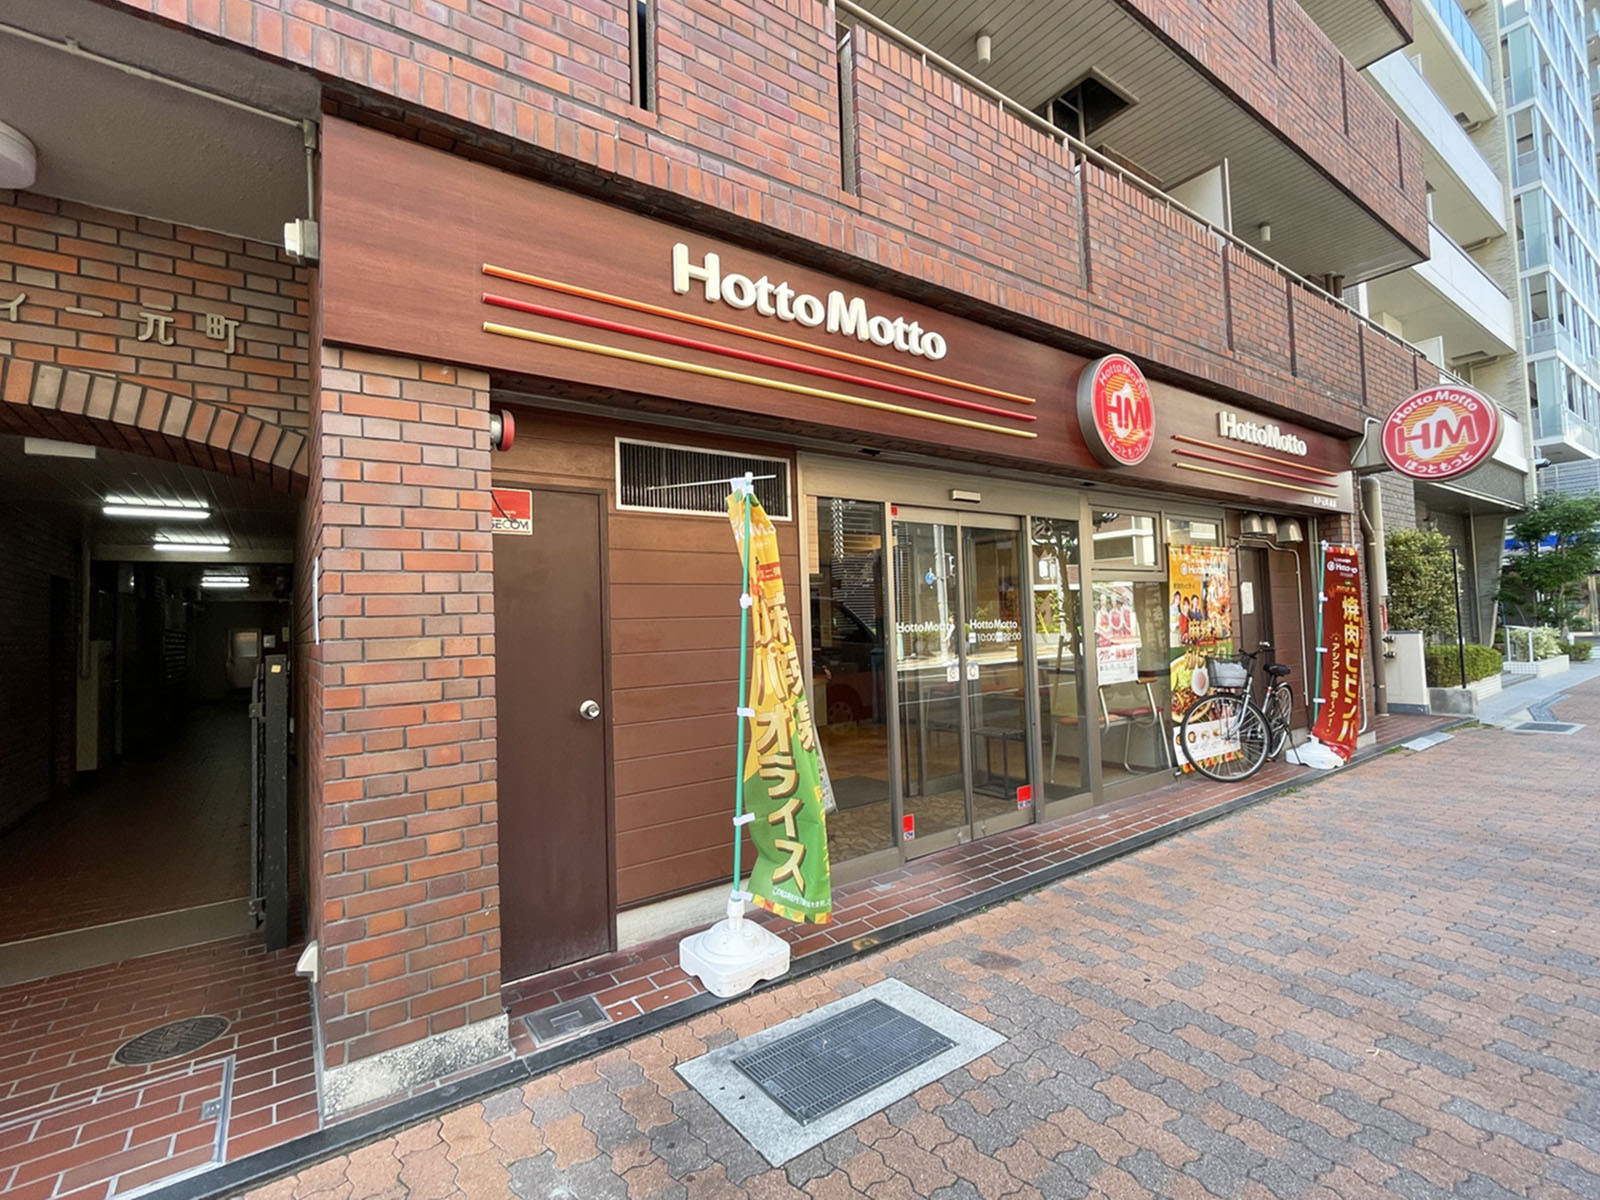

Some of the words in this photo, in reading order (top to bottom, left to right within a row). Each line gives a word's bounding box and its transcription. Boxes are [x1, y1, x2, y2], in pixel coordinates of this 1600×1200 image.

[1102, 390, 1151, 436] HM
[1395, 413, 1479, 456] HM
[1404, 452, 1474, 474] ほっともっと
